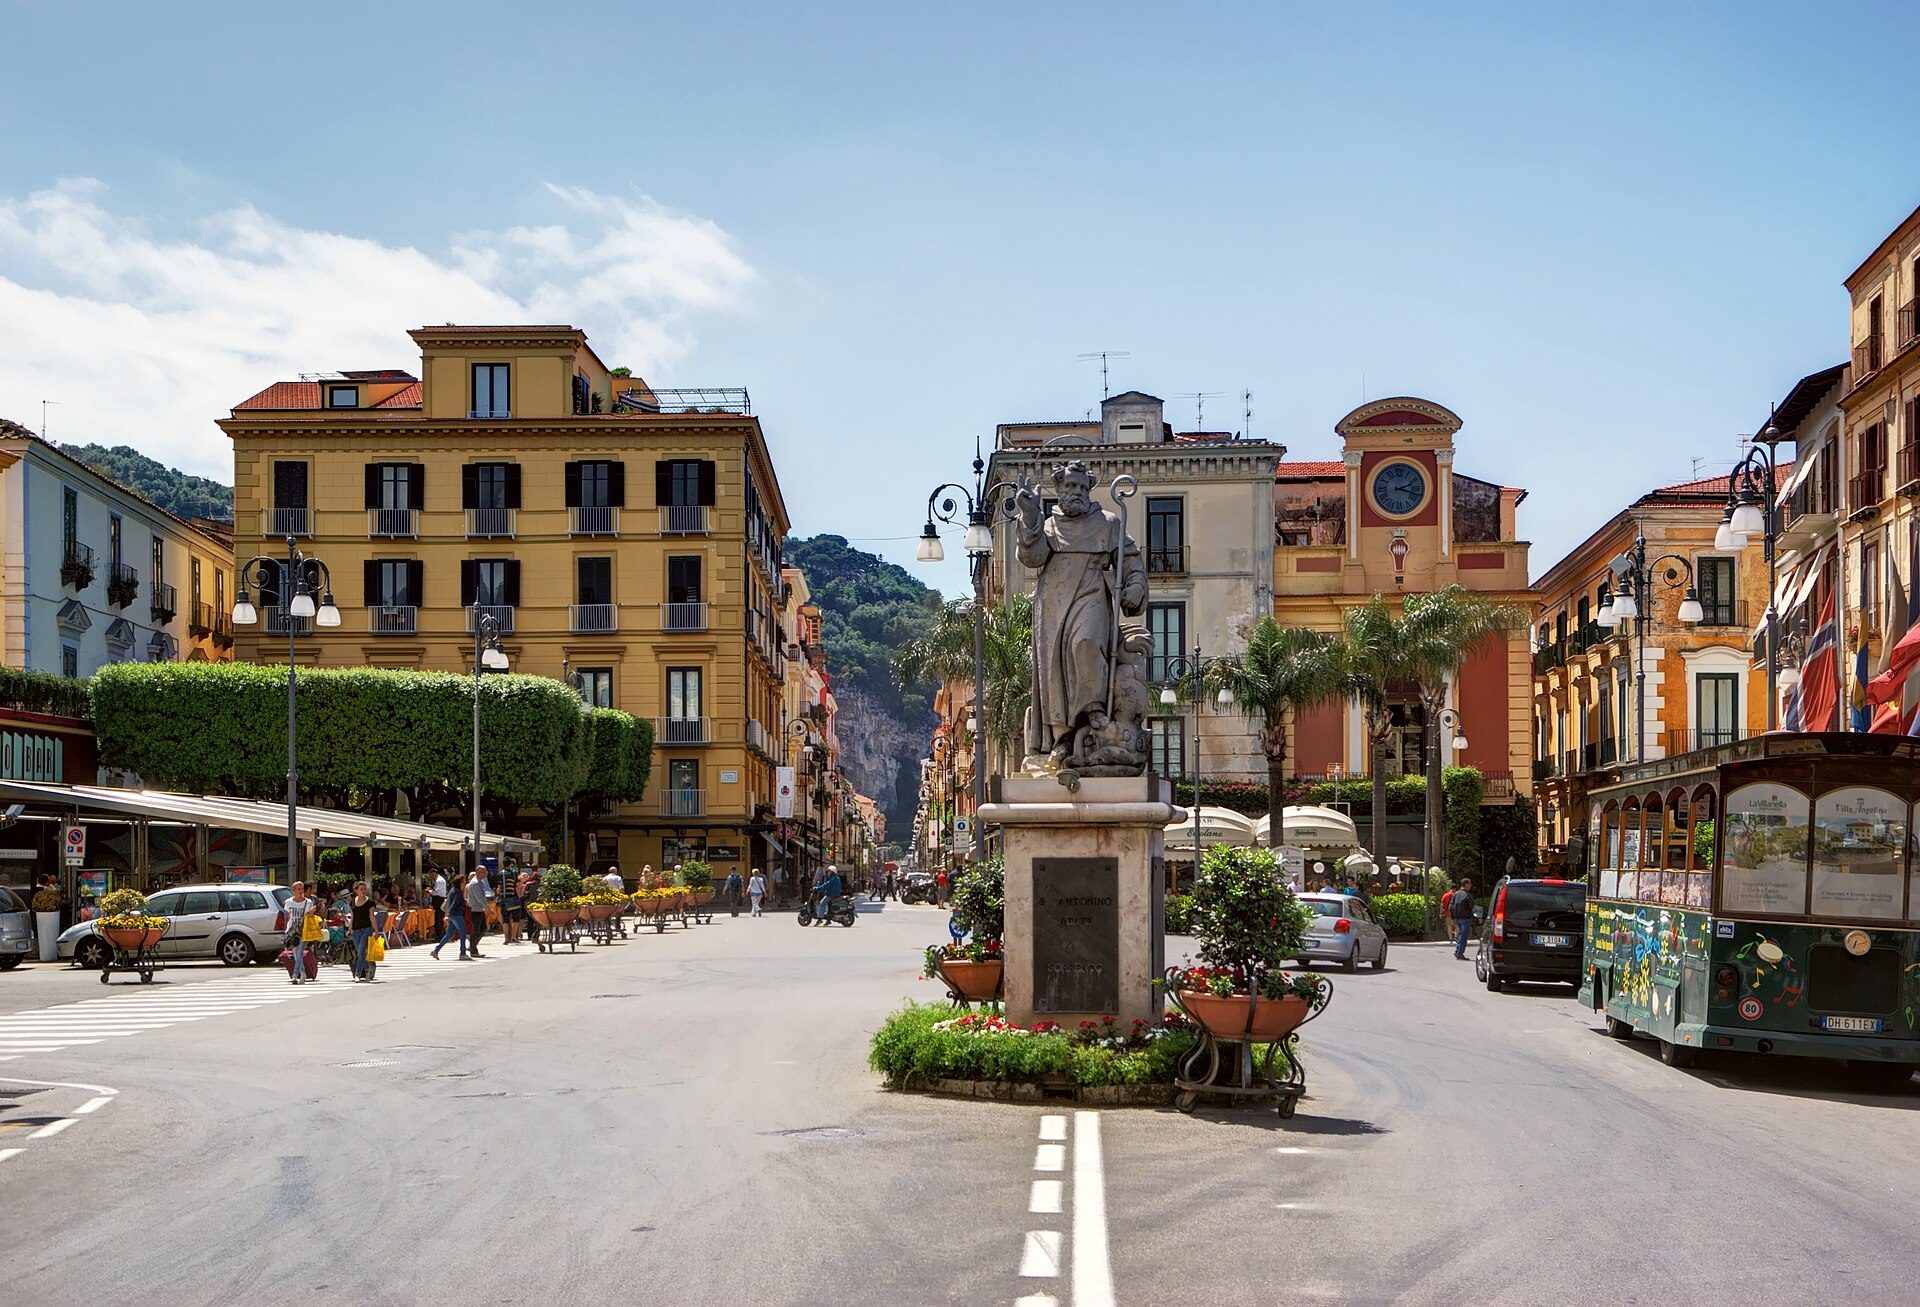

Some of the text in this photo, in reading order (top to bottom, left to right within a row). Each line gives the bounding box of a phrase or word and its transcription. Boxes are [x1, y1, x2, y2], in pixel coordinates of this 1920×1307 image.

[4, 744, 52, 775] O BAR
[1835, 803, 1853, 814] Villa
[1186, 828, 1223, 837] Eolano
[1058, 897, 1113, 907] ANTONINO
[1744, 1003, 1757, 1014] 80
[1828, 1017, 1876, 1030] DH 611EX
